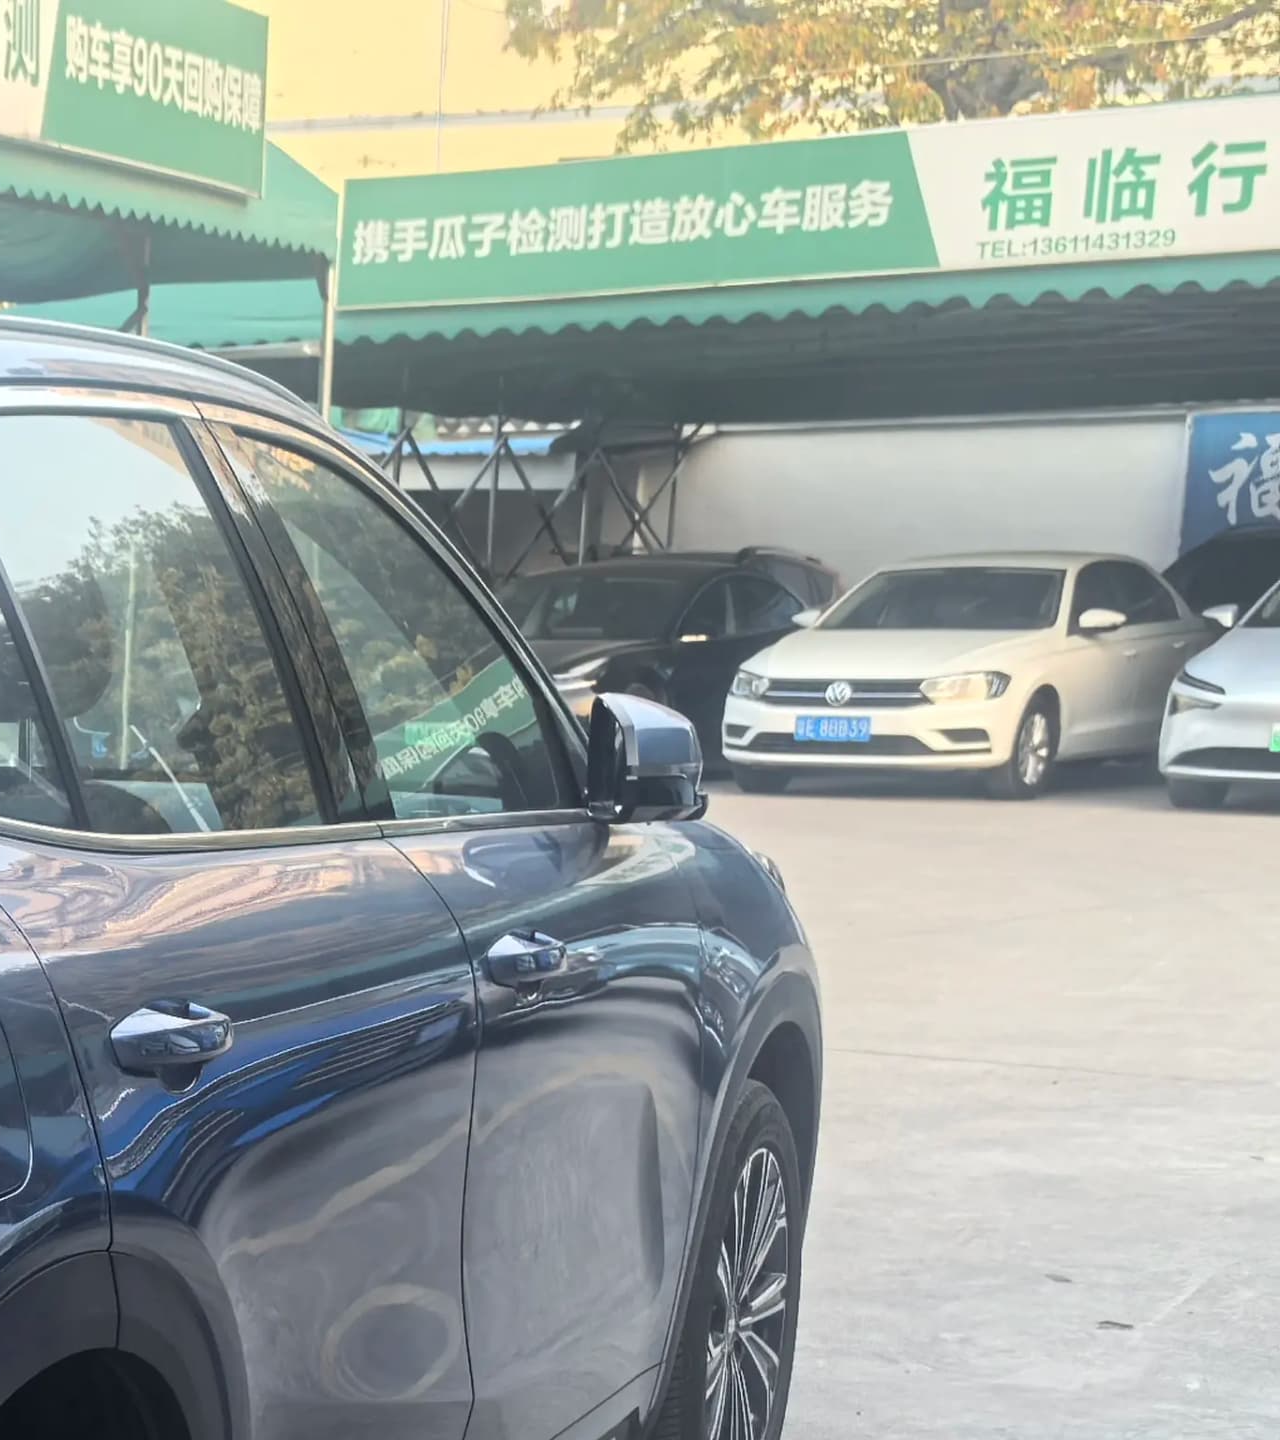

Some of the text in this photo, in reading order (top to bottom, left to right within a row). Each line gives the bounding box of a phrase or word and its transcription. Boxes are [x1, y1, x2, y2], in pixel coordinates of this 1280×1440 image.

[64, 14, 264, 135] 购车享90天回购保障
[352, 180, 894, 266] 携手瓜子检测打造放心车服务
[980, 140, 1268, 232] 福临行
